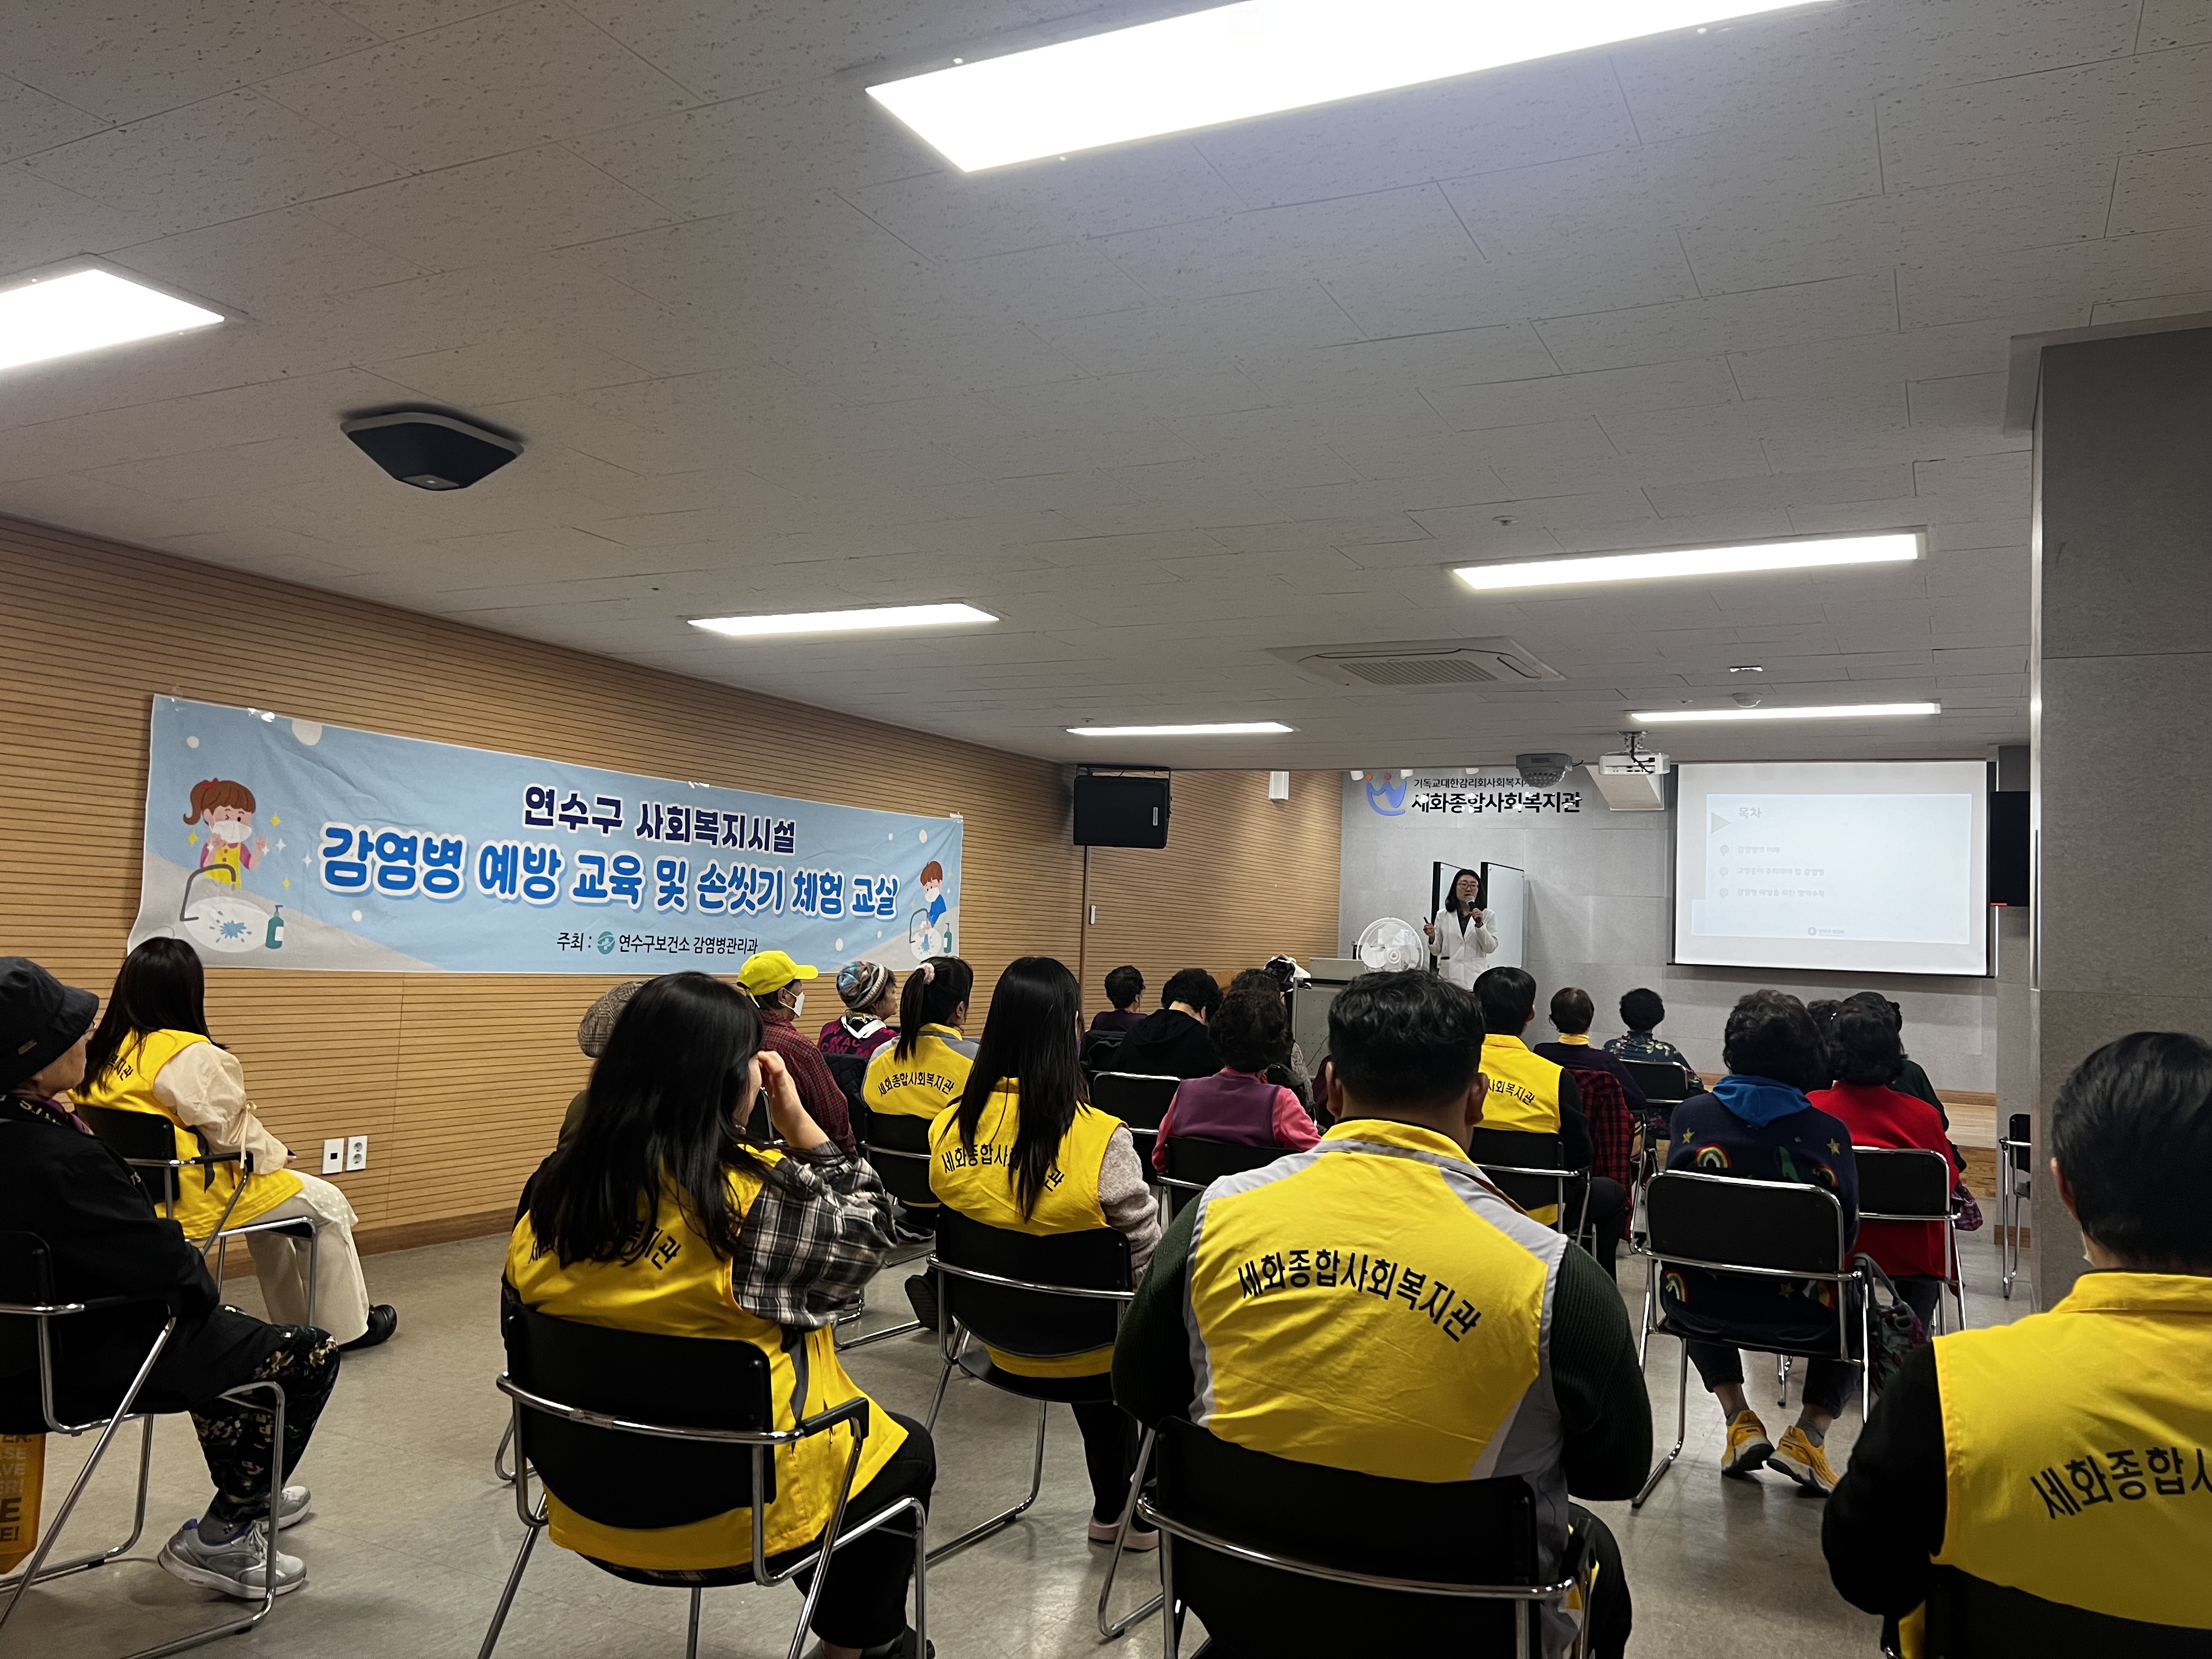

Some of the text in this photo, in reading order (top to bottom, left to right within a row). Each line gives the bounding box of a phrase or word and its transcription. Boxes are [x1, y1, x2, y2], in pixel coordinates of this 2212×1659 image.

[1413, 777, 1531, 789] 기독교대한감리회사회복지
[1411, 792, 1582, 813] 세화종합사회복지관
[1739, 807, 1762, 819] 목차
[525, 787, 795, 854] 연수구 사회복지시설
[323, 827, 899, 917] 감염병 예방 교육 및 손씻기 체험 교실
[556, 932, 584, 952] 주최
[619, 934, 690, 953] 연수구보건소
[693, 936, 759, 956] 감염병관리과
[878, 1071, 955, 1097] 세화종합사회복지관
[1237, 1249, 1481, 1342] 세화종합사회복지관
